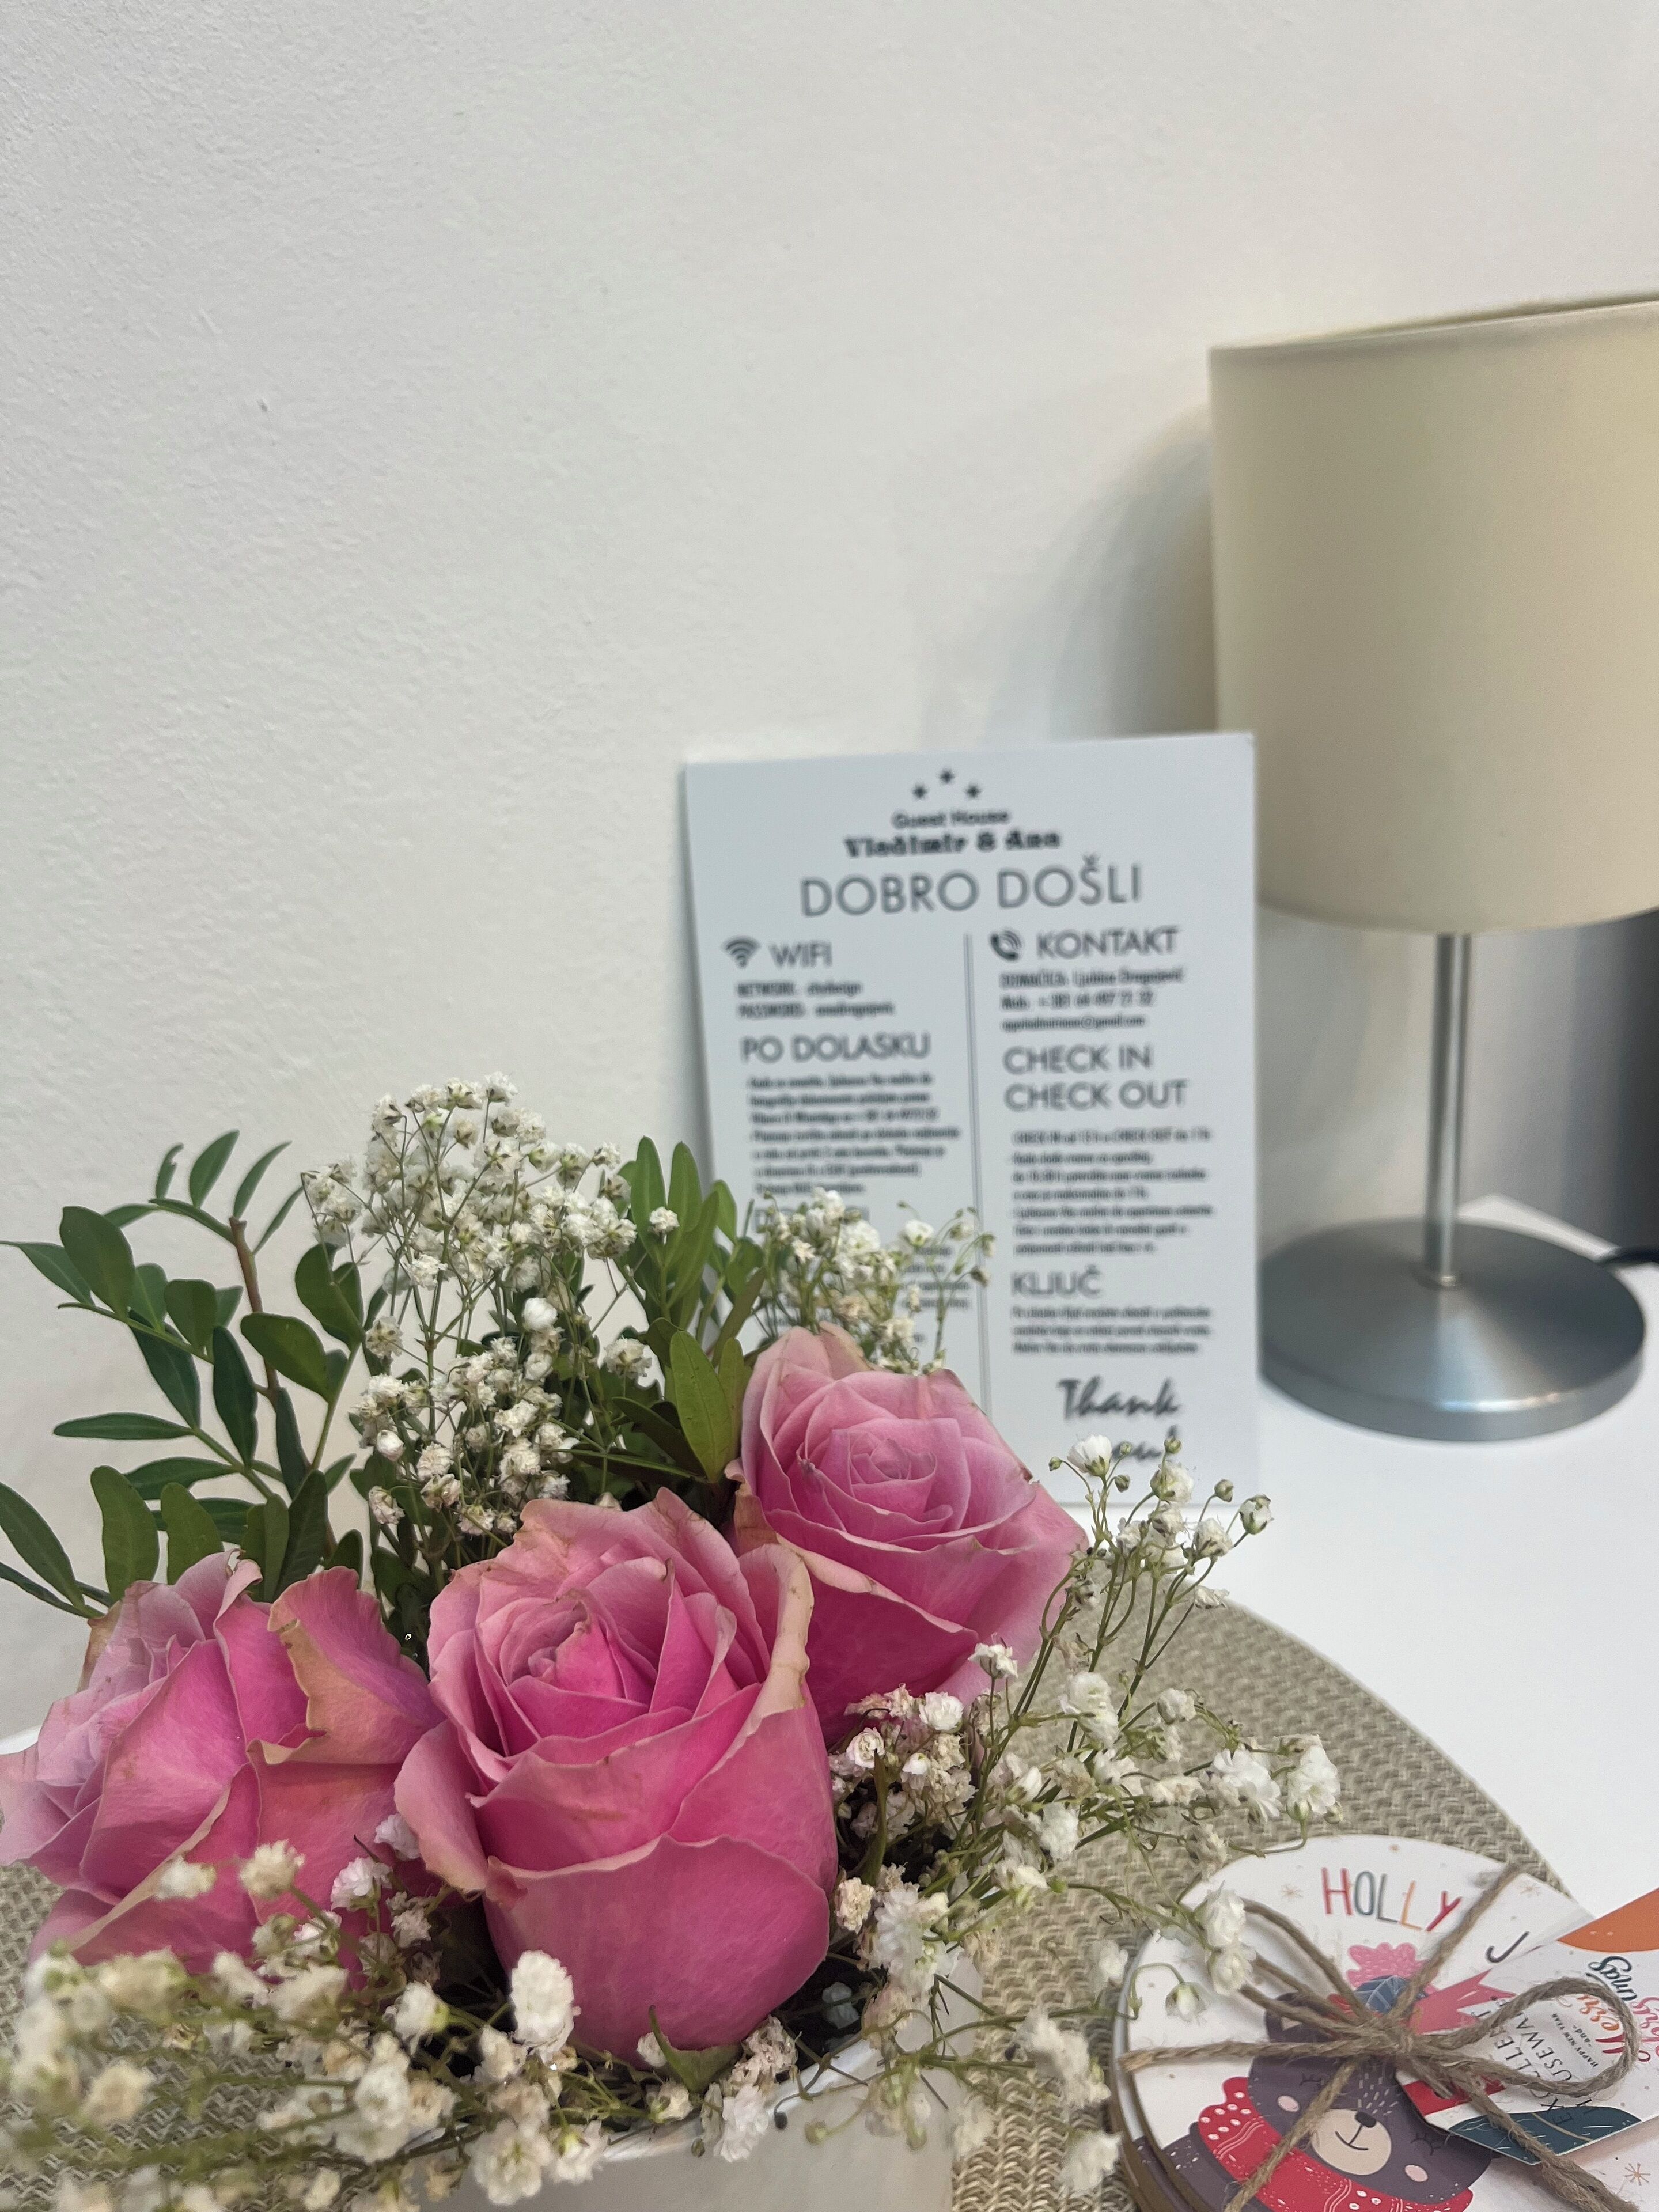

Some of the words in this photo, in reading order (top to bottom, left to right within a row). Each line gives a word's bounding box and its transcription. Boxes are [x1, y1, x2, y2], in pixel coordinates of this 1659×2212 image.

[891, 811, 946, 830] Guest
[950, 810, 1010, 826] House
[843, 833, 968, 858] Vladimir
[800, 870, 979, 918] DOBRO
[997, 853, 1142, 909] DOŠLI
[768, 940, 832, 968] WIFI
[1036, 925, 1179, 960] KONTAKT
[740, 1036, 784, 1064] PO
[790, 1032, 931, 1063] DOLASKU
[1002, 1044, 1109, 1075] CHECK
[1119, 1043, 1153, 1071] IN
[1003, 1081, 1111, 1112] CHECK
[1118, 1078, 1189, 1109] OUT
[1010, 1264, 1103, 1299] KLJUČ
[1056, 1374, 1181, 1420] Thank
[1321, 1866, 1462, 1933] HOLLY
[1551, 2013, 1565, 2031] YEAR
[1563, 2032, 1577, 2046] NEW
[1574, 2047, 1599, 2067] HAPPY
